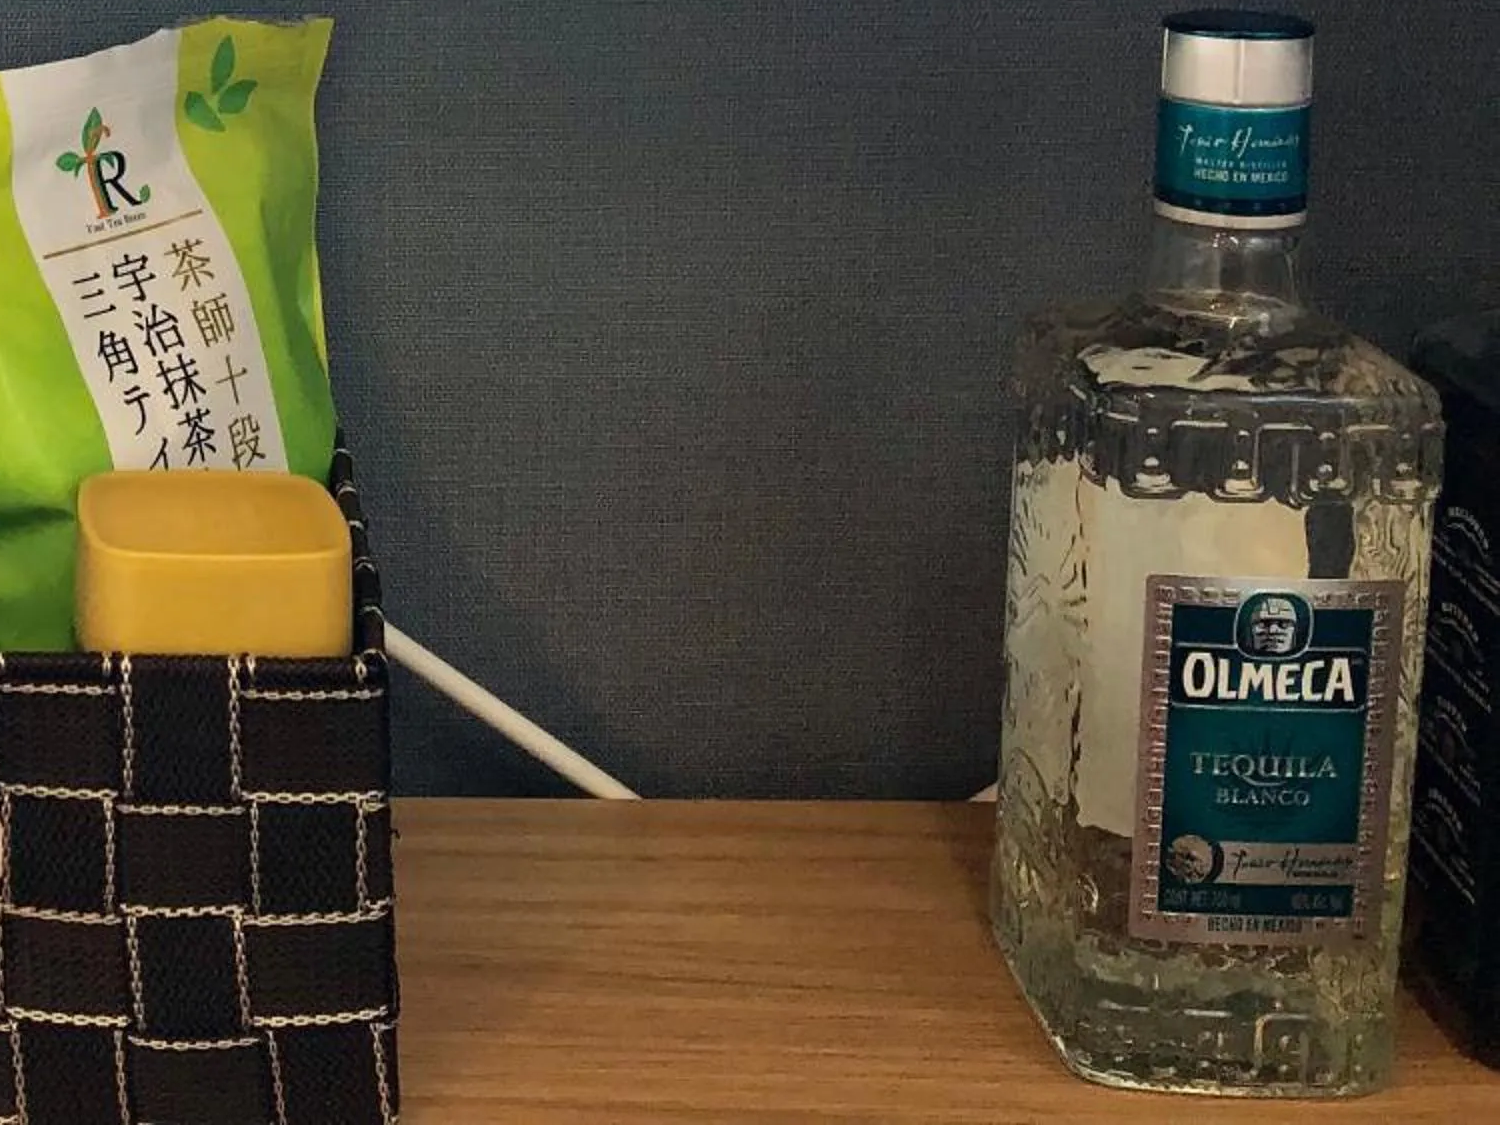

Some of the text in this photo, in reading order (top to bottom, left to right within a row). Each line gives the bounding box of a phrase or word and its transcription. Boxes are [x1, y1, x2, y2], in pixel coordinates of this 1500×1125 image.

[111, 253, 218, 472] 宇治抹茶
[163, 238, 267, 472] 茶師十段
[1182, 650, 1356, 703] OLMECA
[1189, 751, 1338, 787] TEQUILA
[1214, 786, 1311, 807] BLANCO
